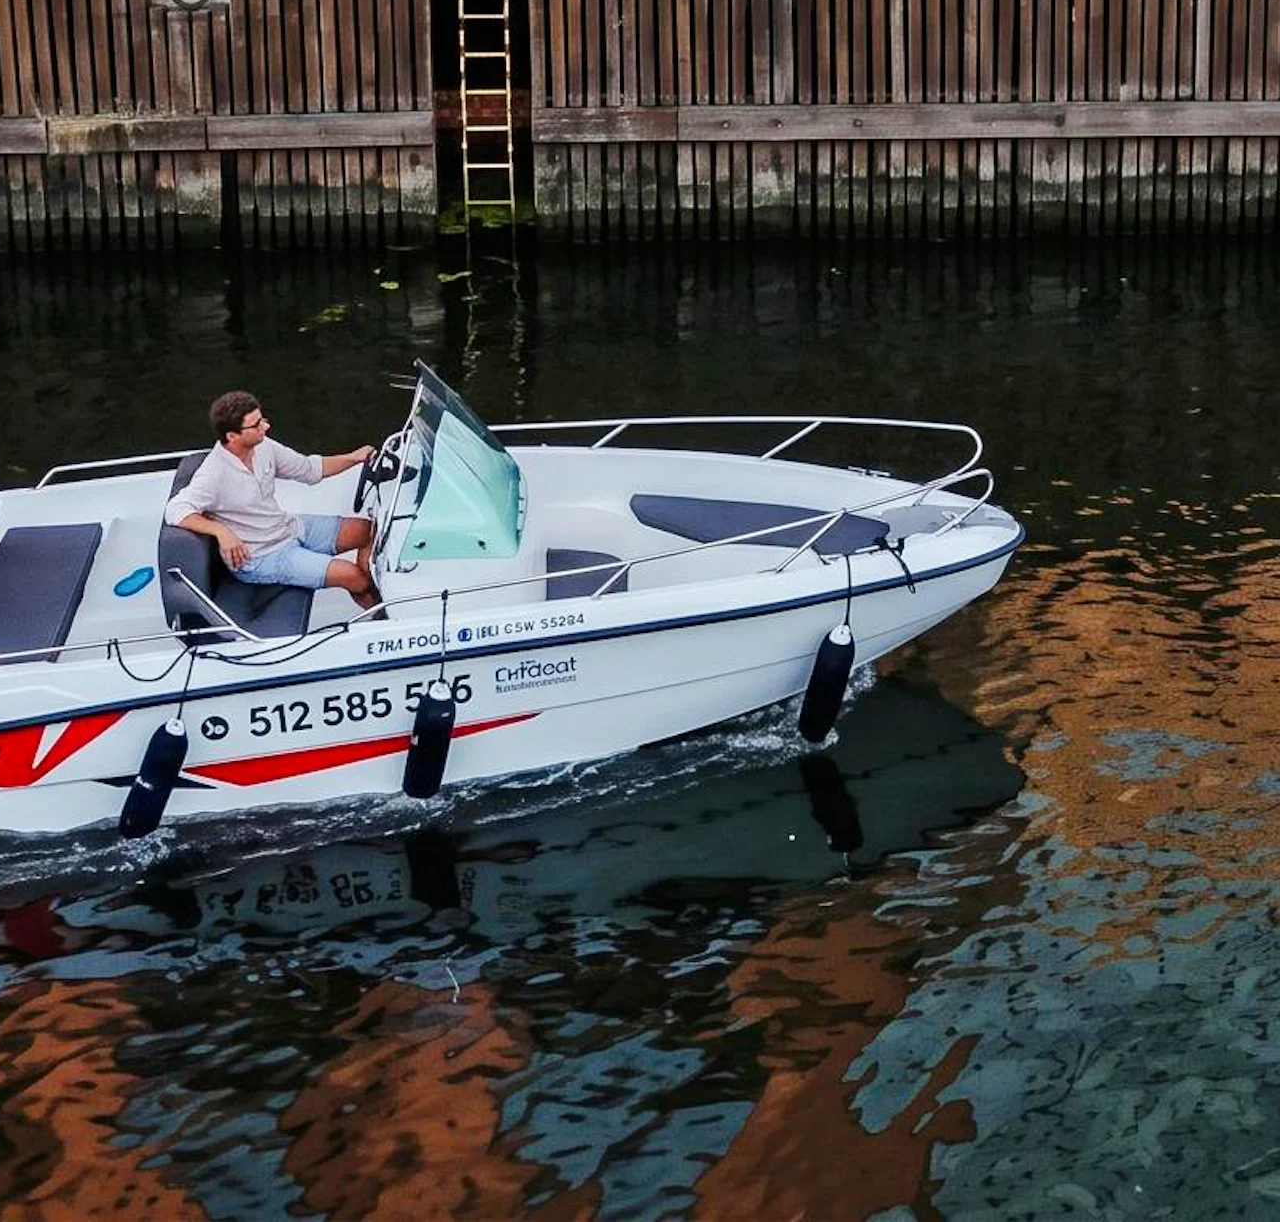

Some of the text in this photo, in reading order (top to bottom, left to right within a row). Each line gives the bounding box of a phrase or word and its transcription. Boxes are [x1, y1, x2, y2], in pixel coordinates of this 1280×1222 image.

[250, 701, 313, 737] 512
[322, 687, 392, 726] 585
[404, 674, 473, 713] 56
